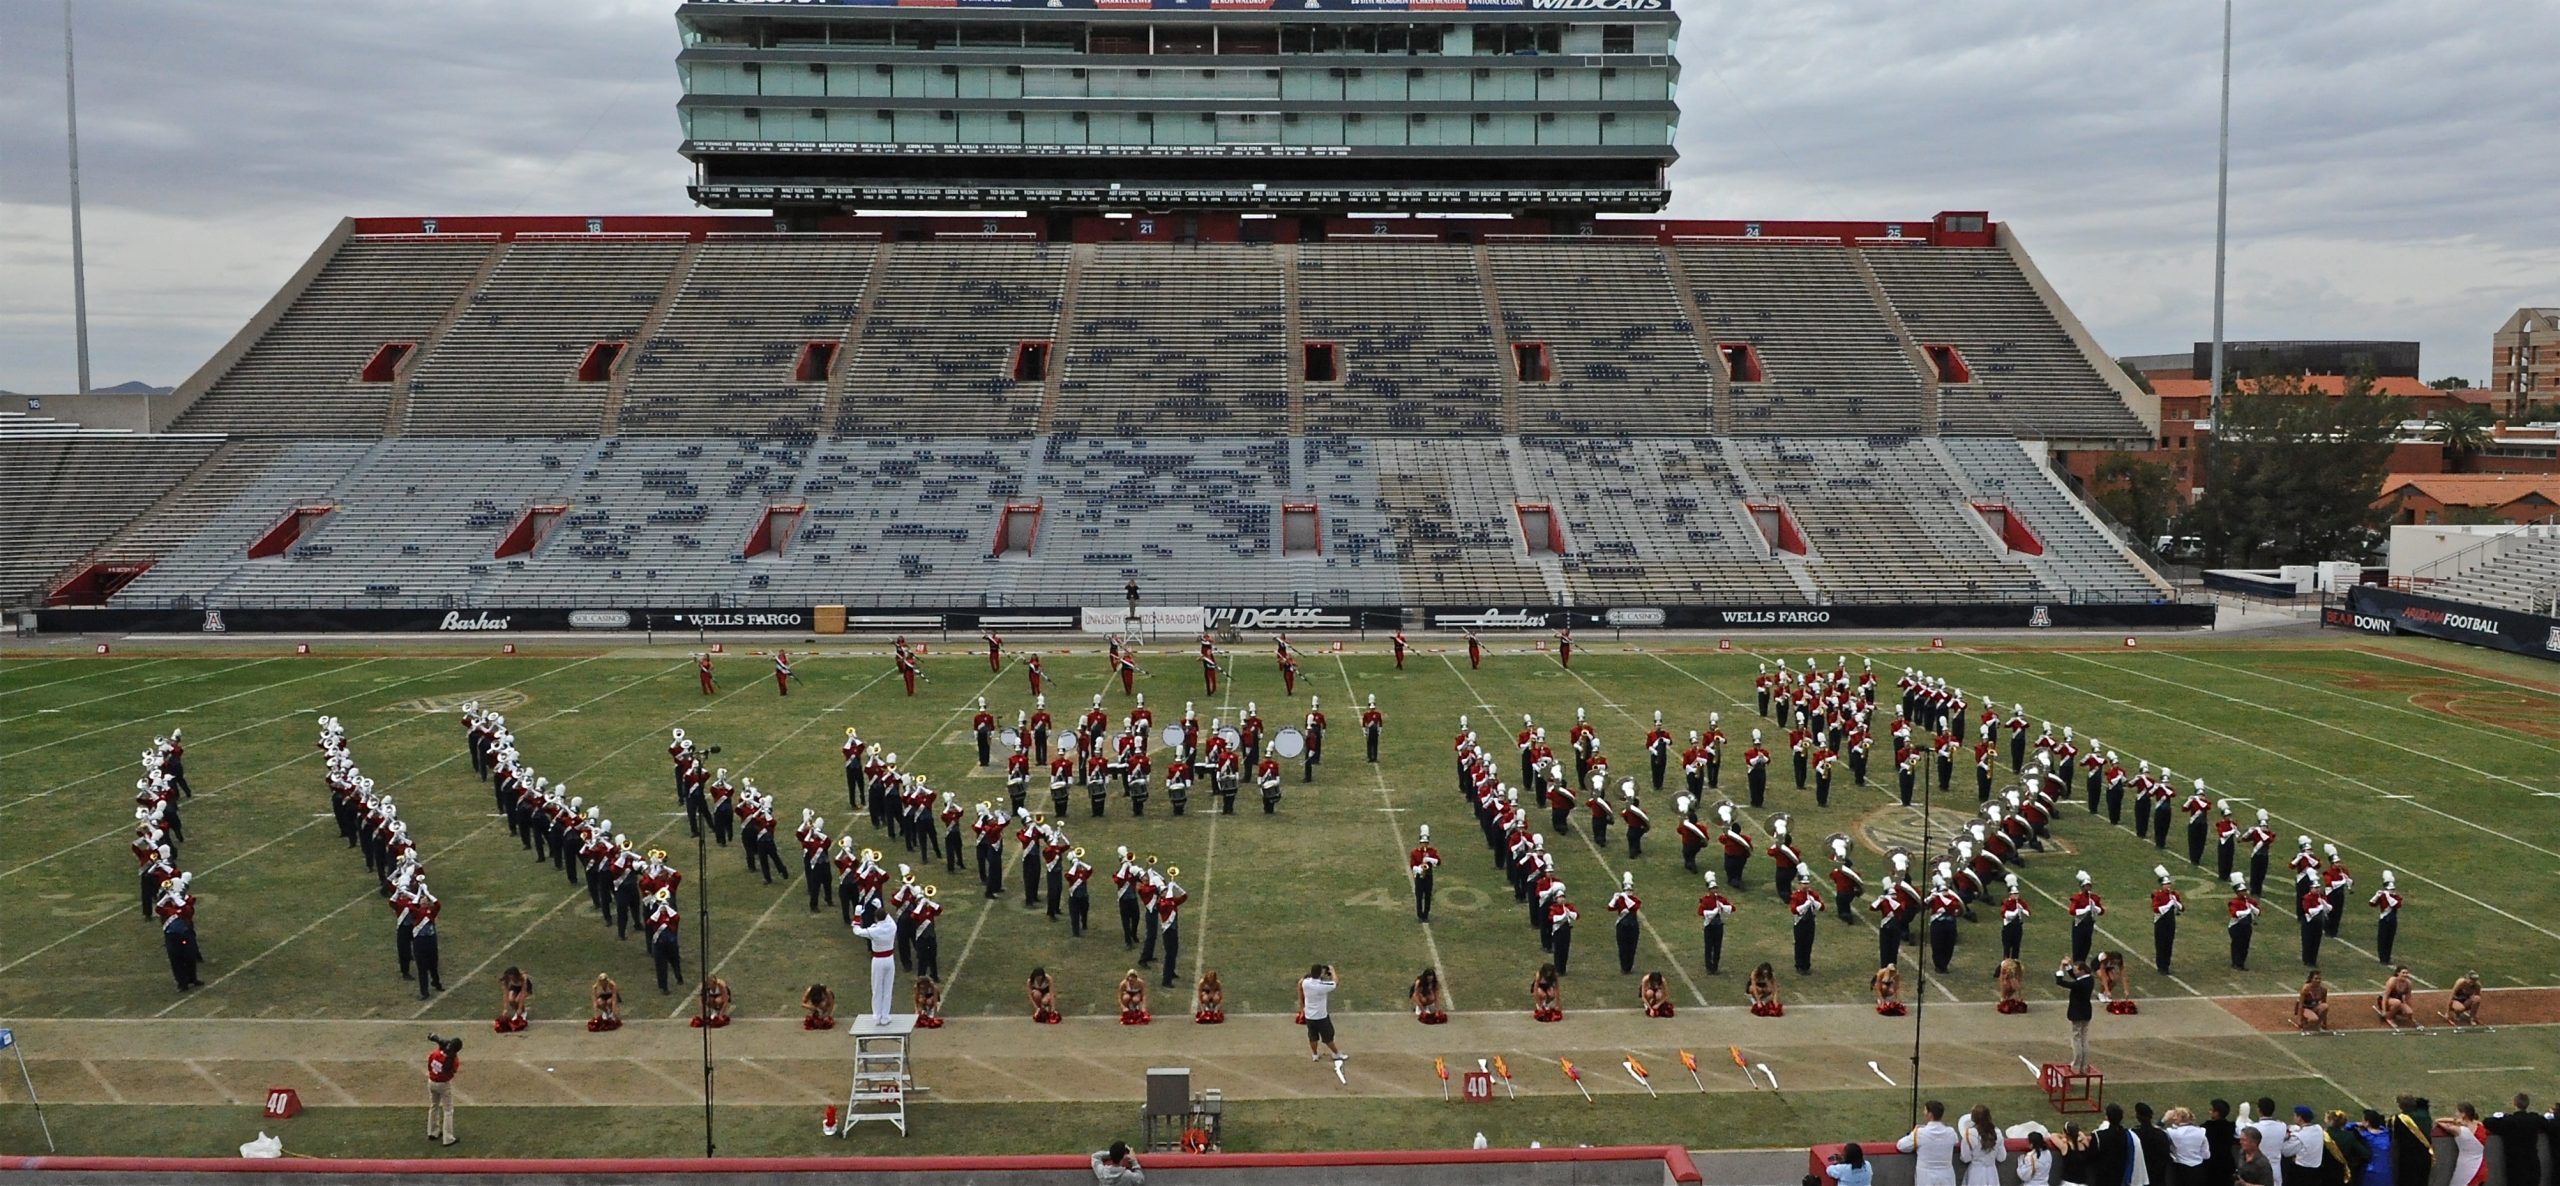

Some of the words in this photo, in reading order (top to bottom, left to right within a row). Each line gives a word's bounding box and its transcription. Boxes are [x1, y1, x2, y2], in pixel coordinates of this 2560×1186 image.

[424, 224, 436, 234] 17
[588, 223, 601, 233] 18
[1140, 224, 1152, 234] 21
[1746, 227, 1759, 237] 24
[1888, 228, 1901, 238] 25
[29, 400, 40, 409] 16
[439, 610, 511, 631] Bashas'
[688, 614, 745, 626] WELLS
[746, 613, 801, 626] FARGO
[1721, 611, 1775, 623] WELLS
[1778, 611, 1830, 623] FARGO
[2354, 615, 2391, 632] DOWN
[2443, 613, 2499, 634] FOOTBALL
[1468, 1077, 1487, 1096] 40
[267, 1092, 288, 1115] 40
